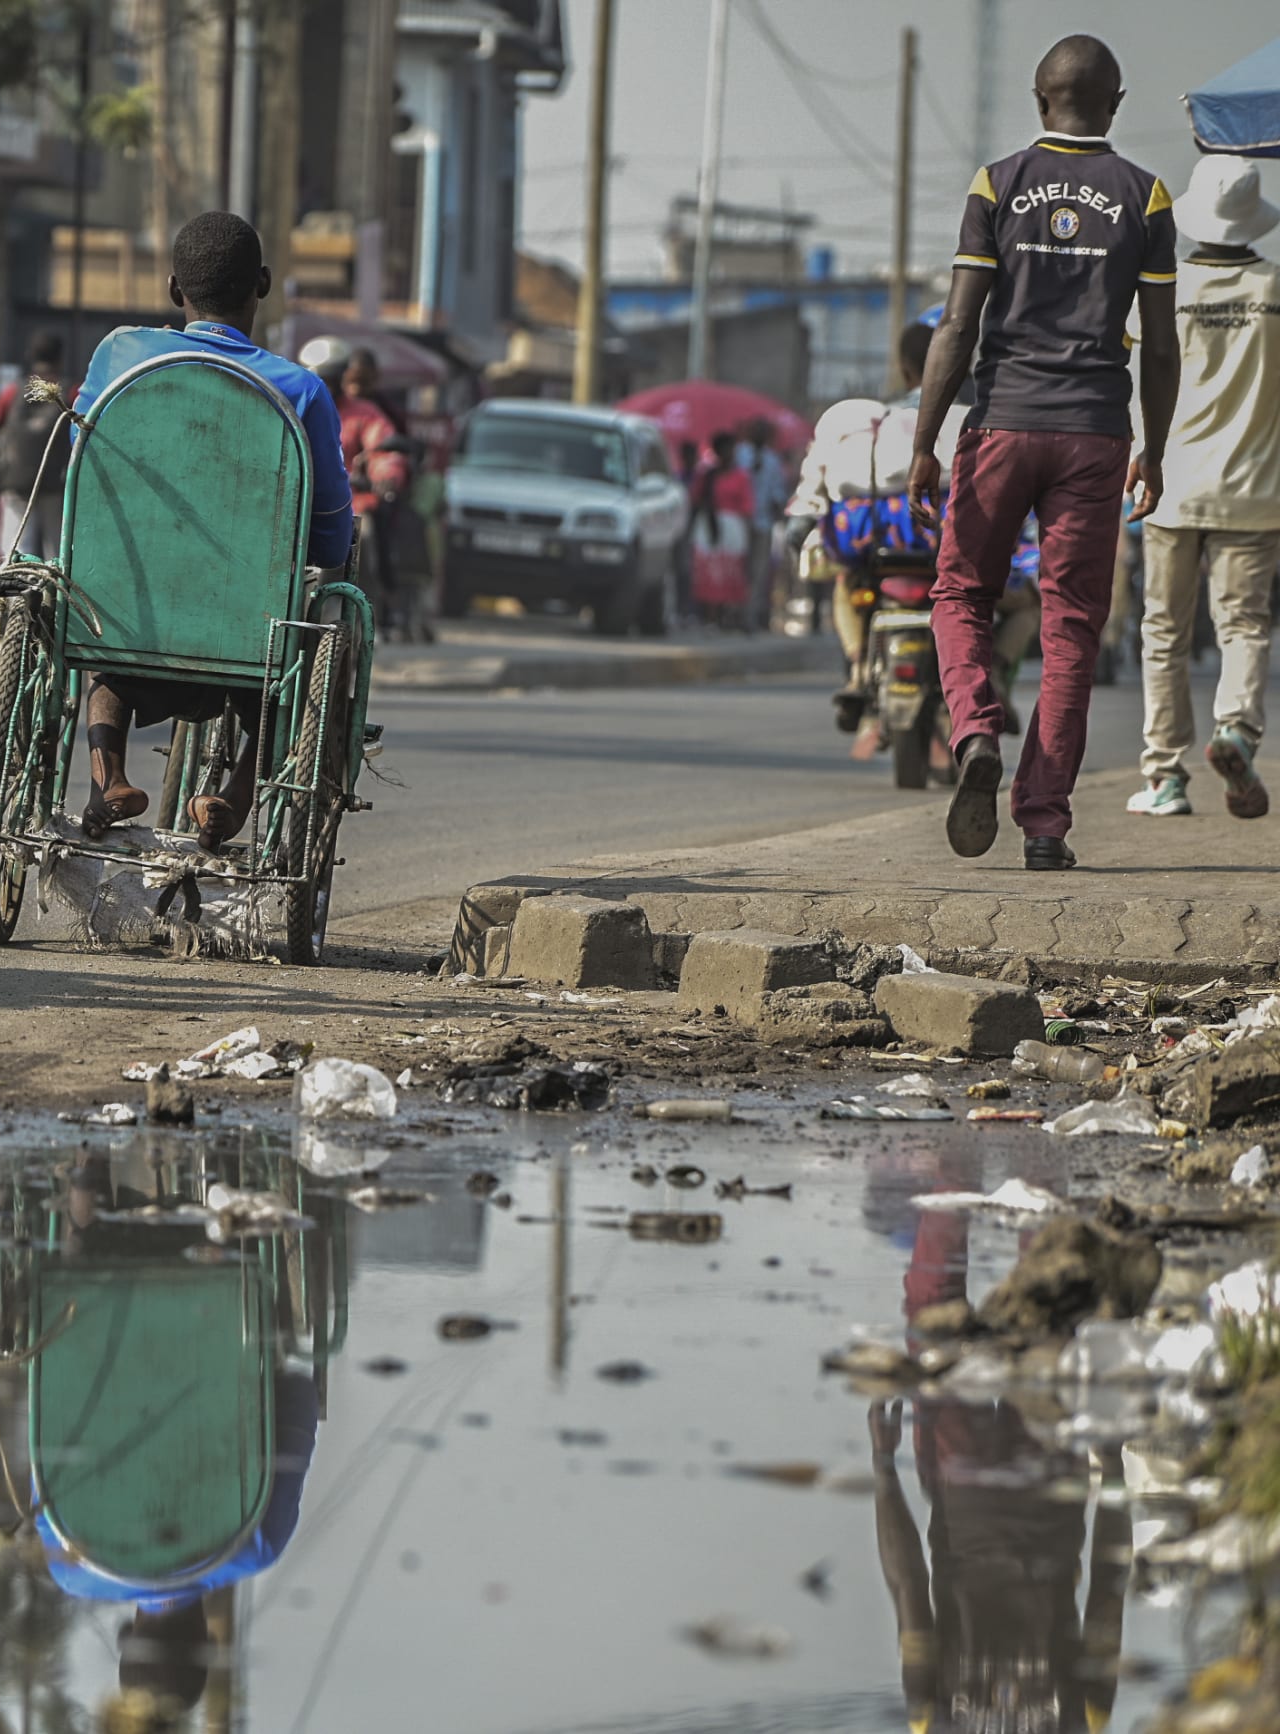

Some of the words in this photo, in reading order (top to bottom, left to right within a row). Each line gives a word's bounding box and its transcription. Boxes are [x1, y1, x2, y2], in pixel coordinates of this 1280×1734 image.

[1011, 182, 1123, 224] CHELSEA
[1017, 243, 1052, 253] FOOTBALL
[1053, 246, 1070, 254] CLUB
